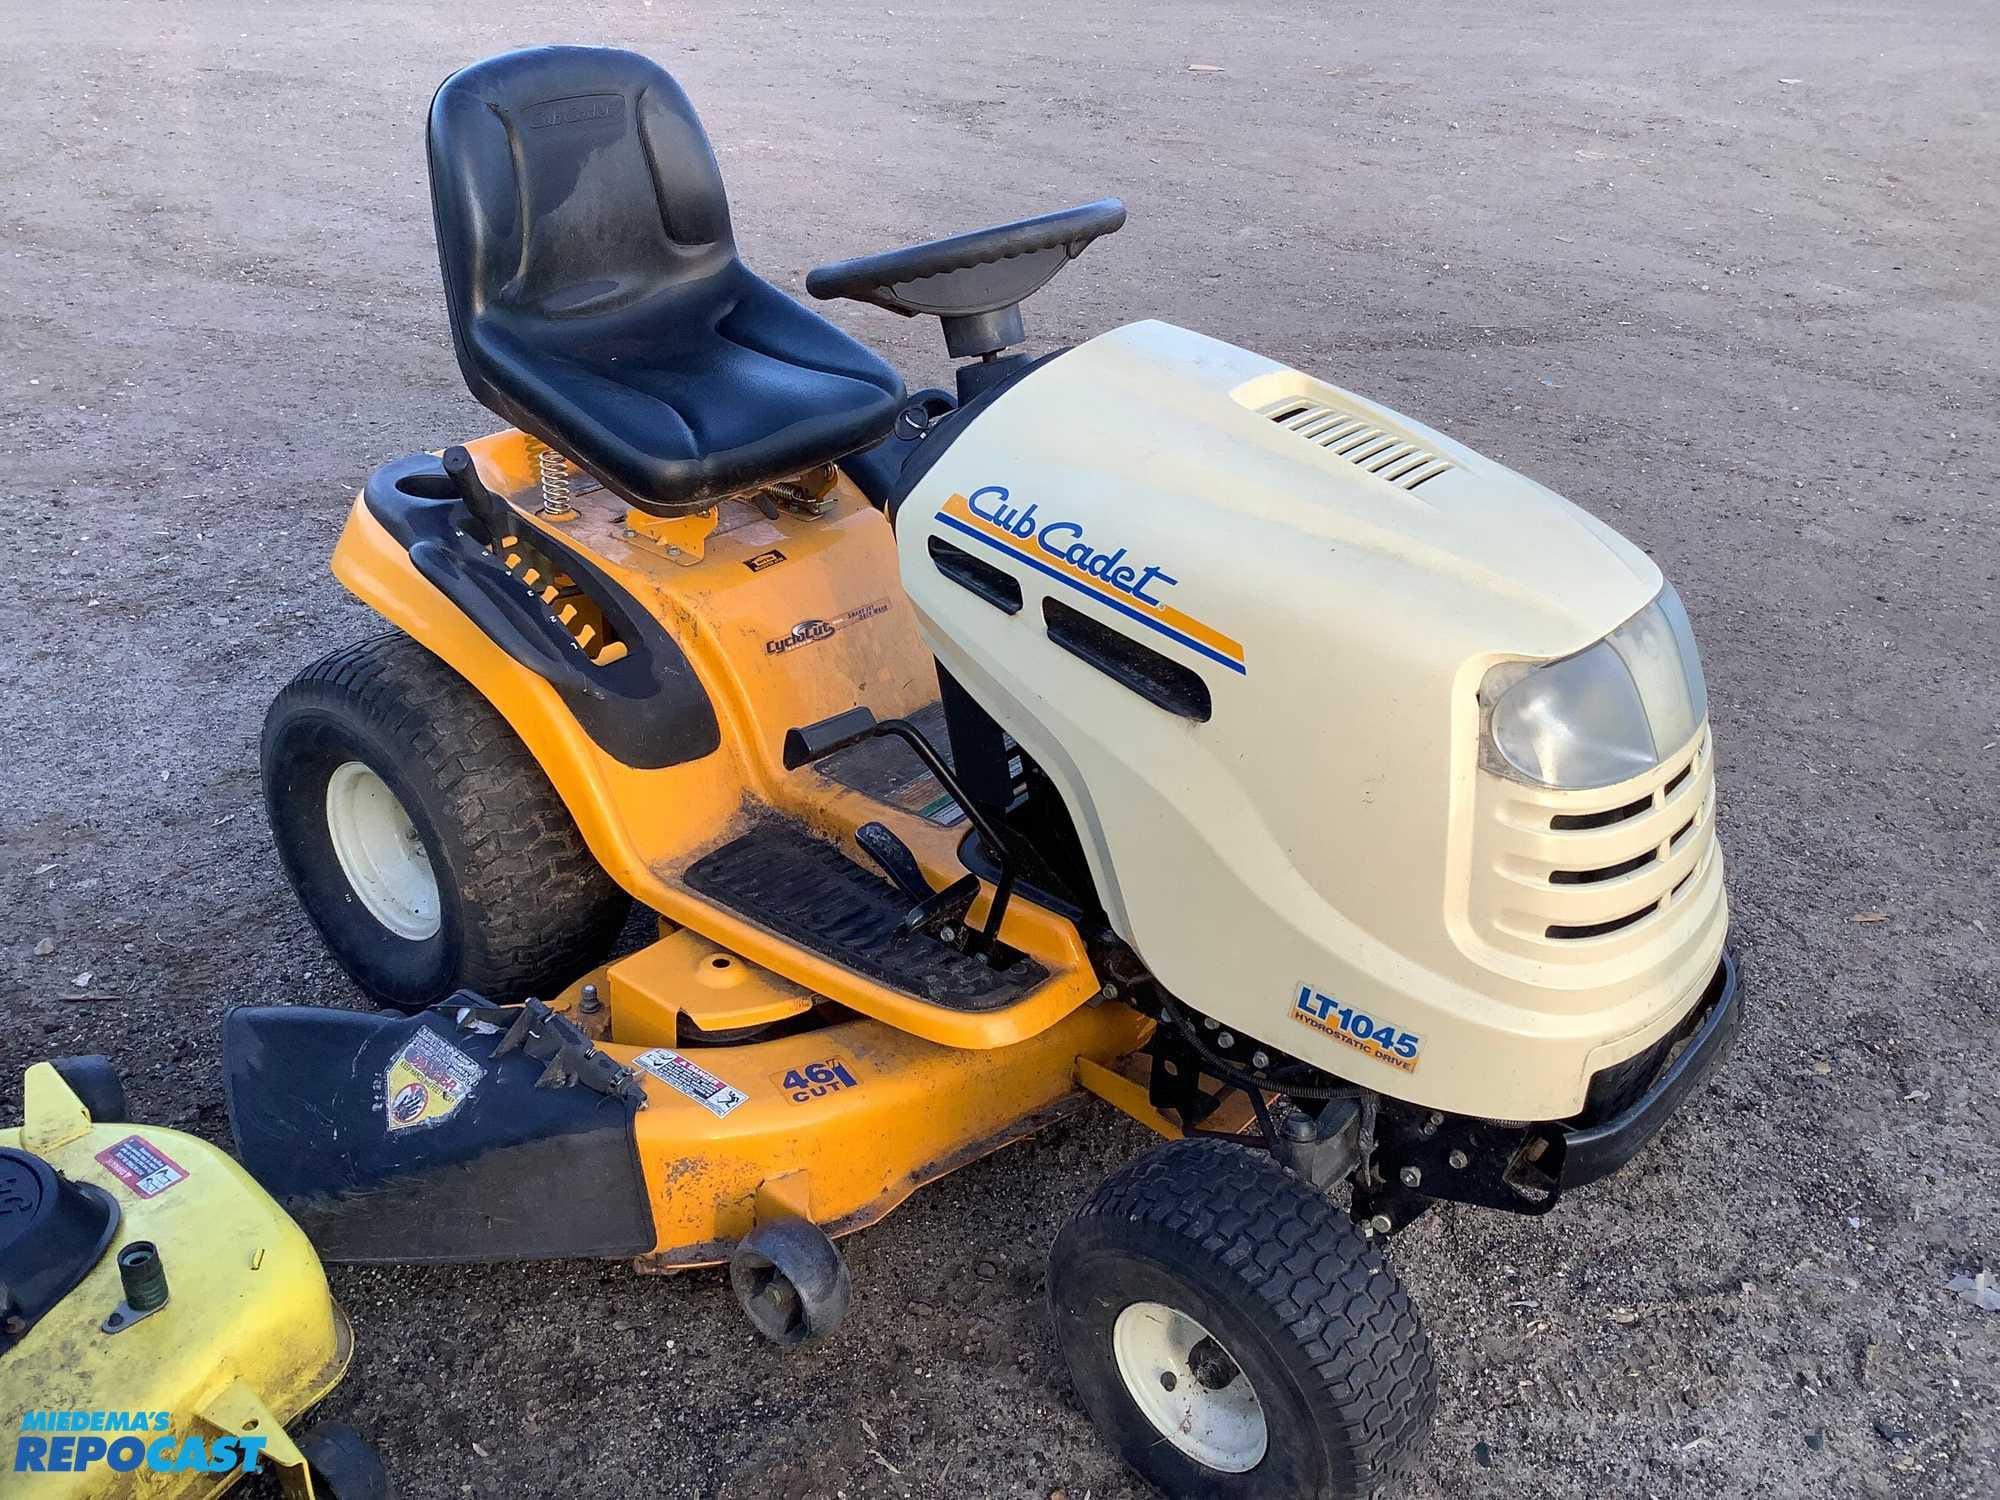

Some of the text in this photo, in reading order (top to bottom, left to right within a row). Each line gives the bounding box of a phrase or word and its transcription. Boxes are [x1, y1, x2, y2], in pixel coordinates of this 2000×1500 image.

[968, 486, 1178, 606] Cub Cadet
[1295, 1011, 1411, 1070] HYDROSTATIC DRIVE
[687, 1064, 720, 1086] DANGER
[792, 1081, 840, 1102] CUT
